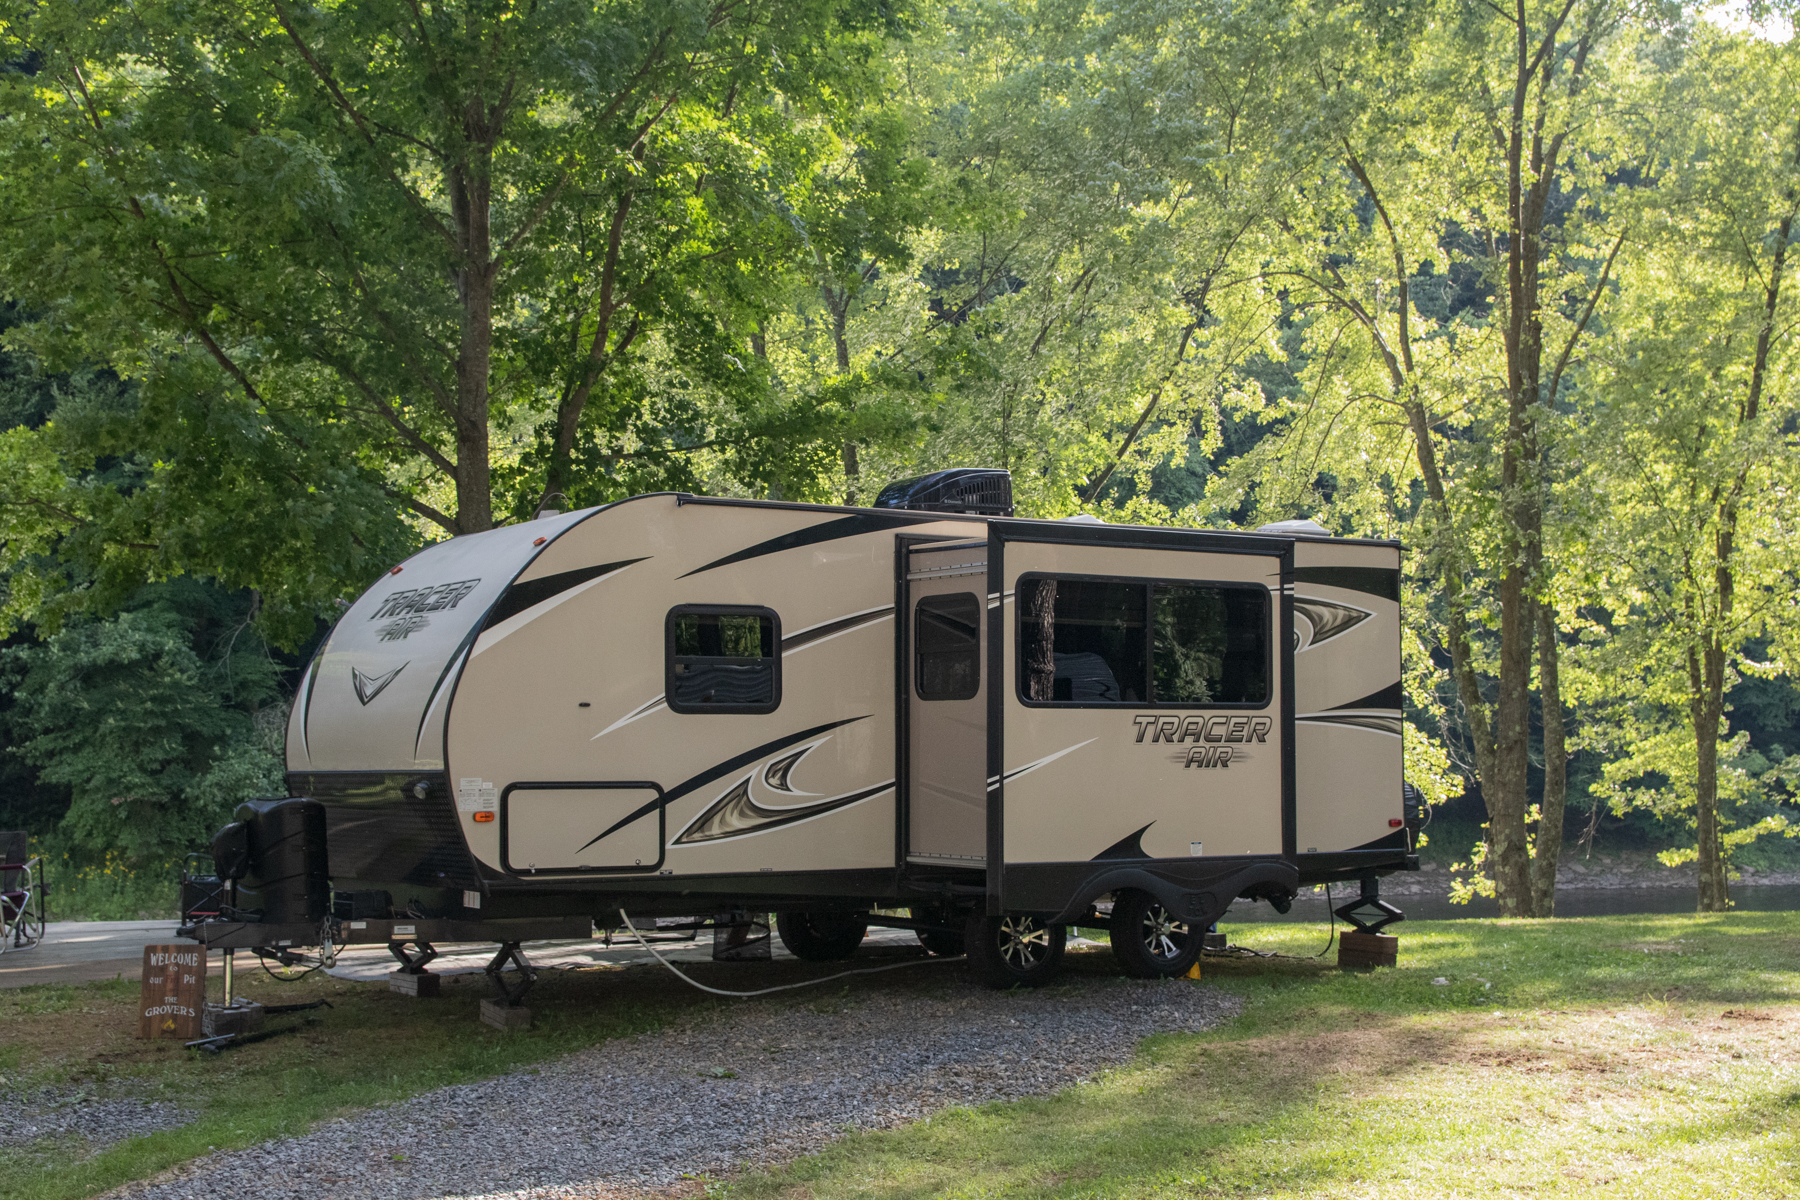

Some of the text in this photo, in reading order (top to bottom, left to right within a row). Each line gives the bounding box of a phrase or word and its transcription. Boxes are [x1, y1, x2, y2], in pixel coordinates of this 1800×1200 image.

[368, 578, 482, 621] TRACER
[378, 615, 423, 643] AIR
[1133, 715, 1272, 744] TRACER
[1184, 746, 1234, 769] AIR
[150, 953, 198, 966] WELCOME
[183, 974, 196, 984] Pit
[145, 1005, 195, 1017] GROVERS
